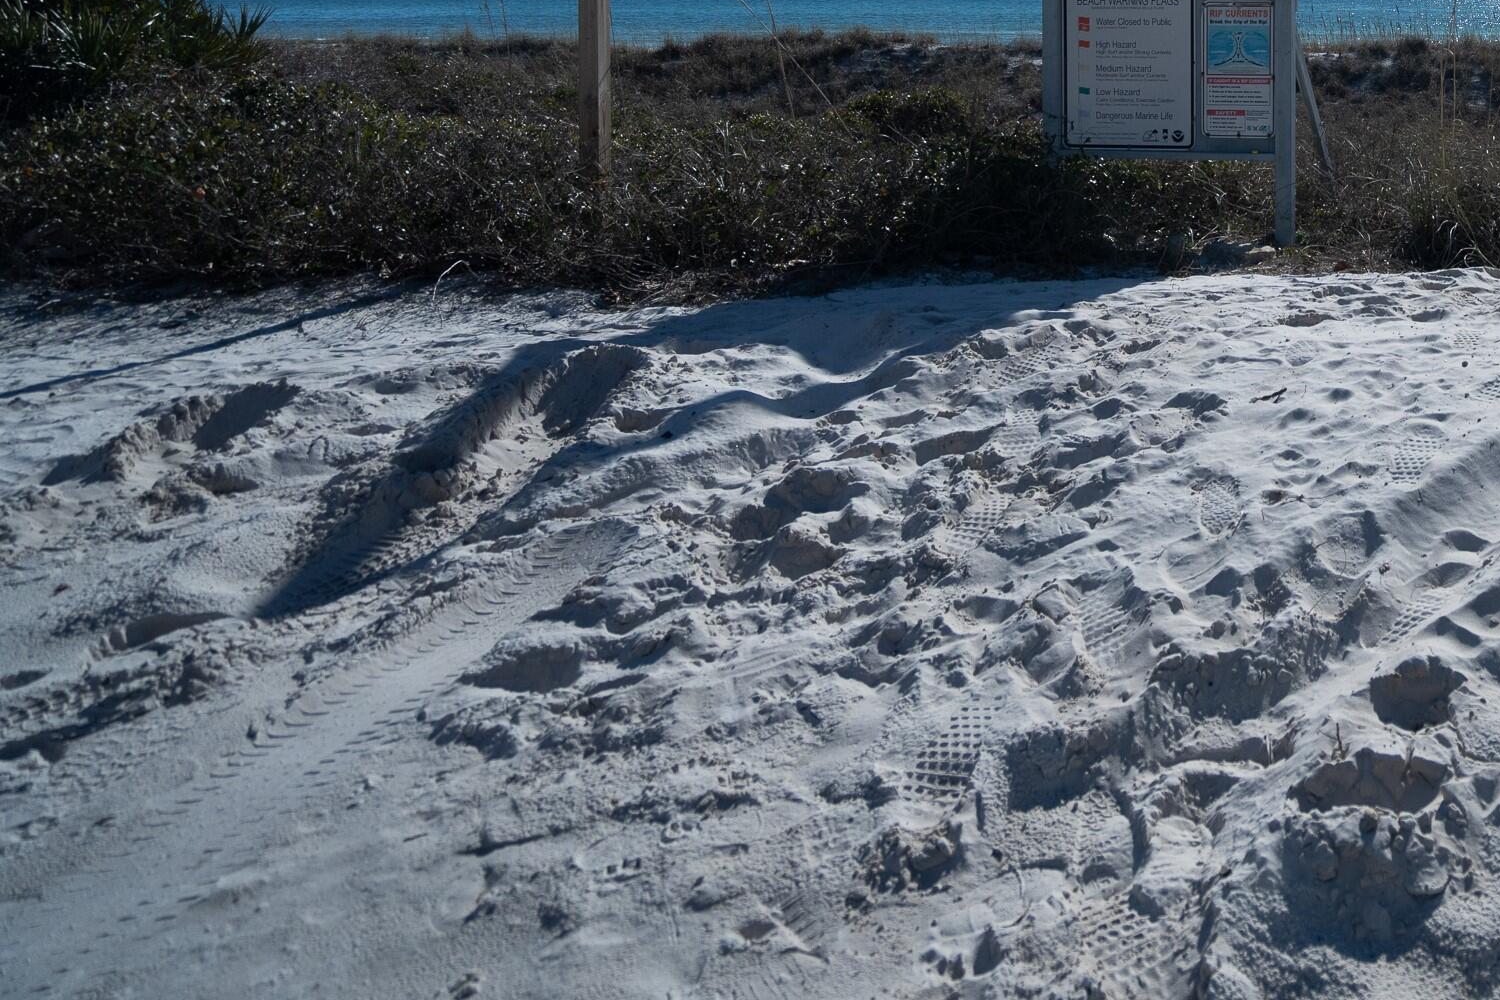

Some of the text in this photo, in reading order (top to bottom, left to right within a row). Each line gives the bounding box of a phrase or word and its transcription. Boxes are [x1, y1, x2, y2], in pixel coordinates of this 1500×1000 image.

[1209, 9, 1269, 18] RIP CURRENTS
[1095, 18, 1173, 26] Water Closed to Public
[1095, 41, 1137, 50] High Hazard
[1095, 65, 1152, 73] Medium Hazard
[1095, 88, 1141, 96] Low Hazard
[1095, 112, 1174, 121] Dangerous Marine Life
